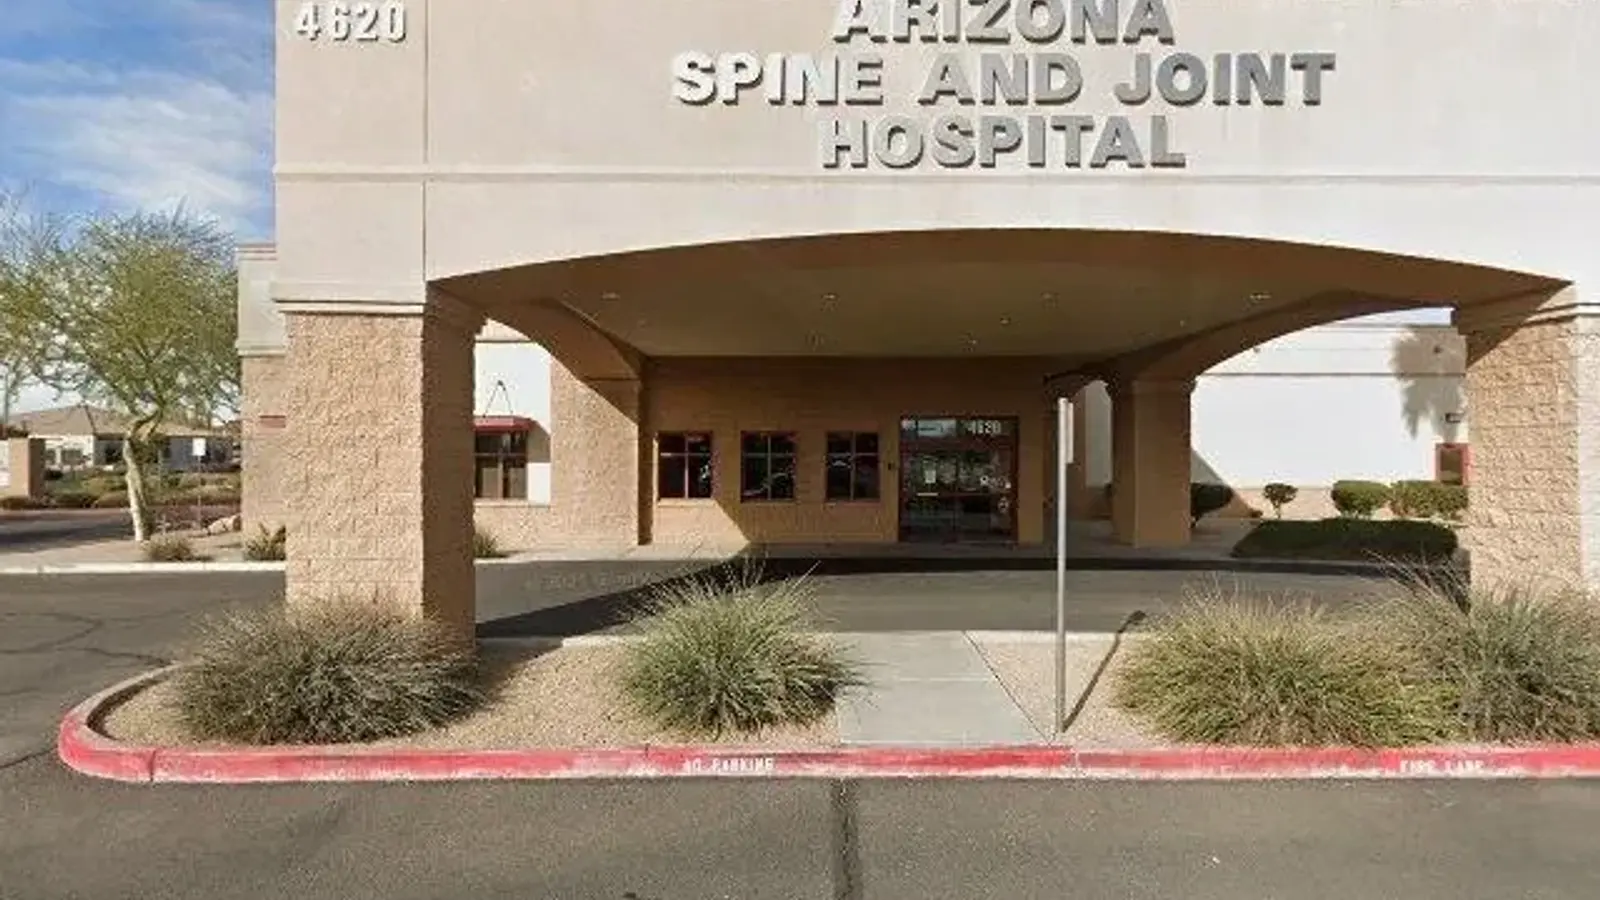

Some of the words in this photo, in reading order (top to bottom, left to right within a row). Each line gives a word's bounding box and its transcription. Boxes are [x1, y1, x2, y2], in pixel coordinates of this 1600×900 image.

[295, 1, 406, 43] 4620
[832, 0, 1175, 44] ARIZONA
[673, 51, 883, 105] SPINE
[917, 52, 1083, 106] AND
[1113, 52, 1336, 106] JOINT
[820, 114, 1187, 169] HOSPITAL
